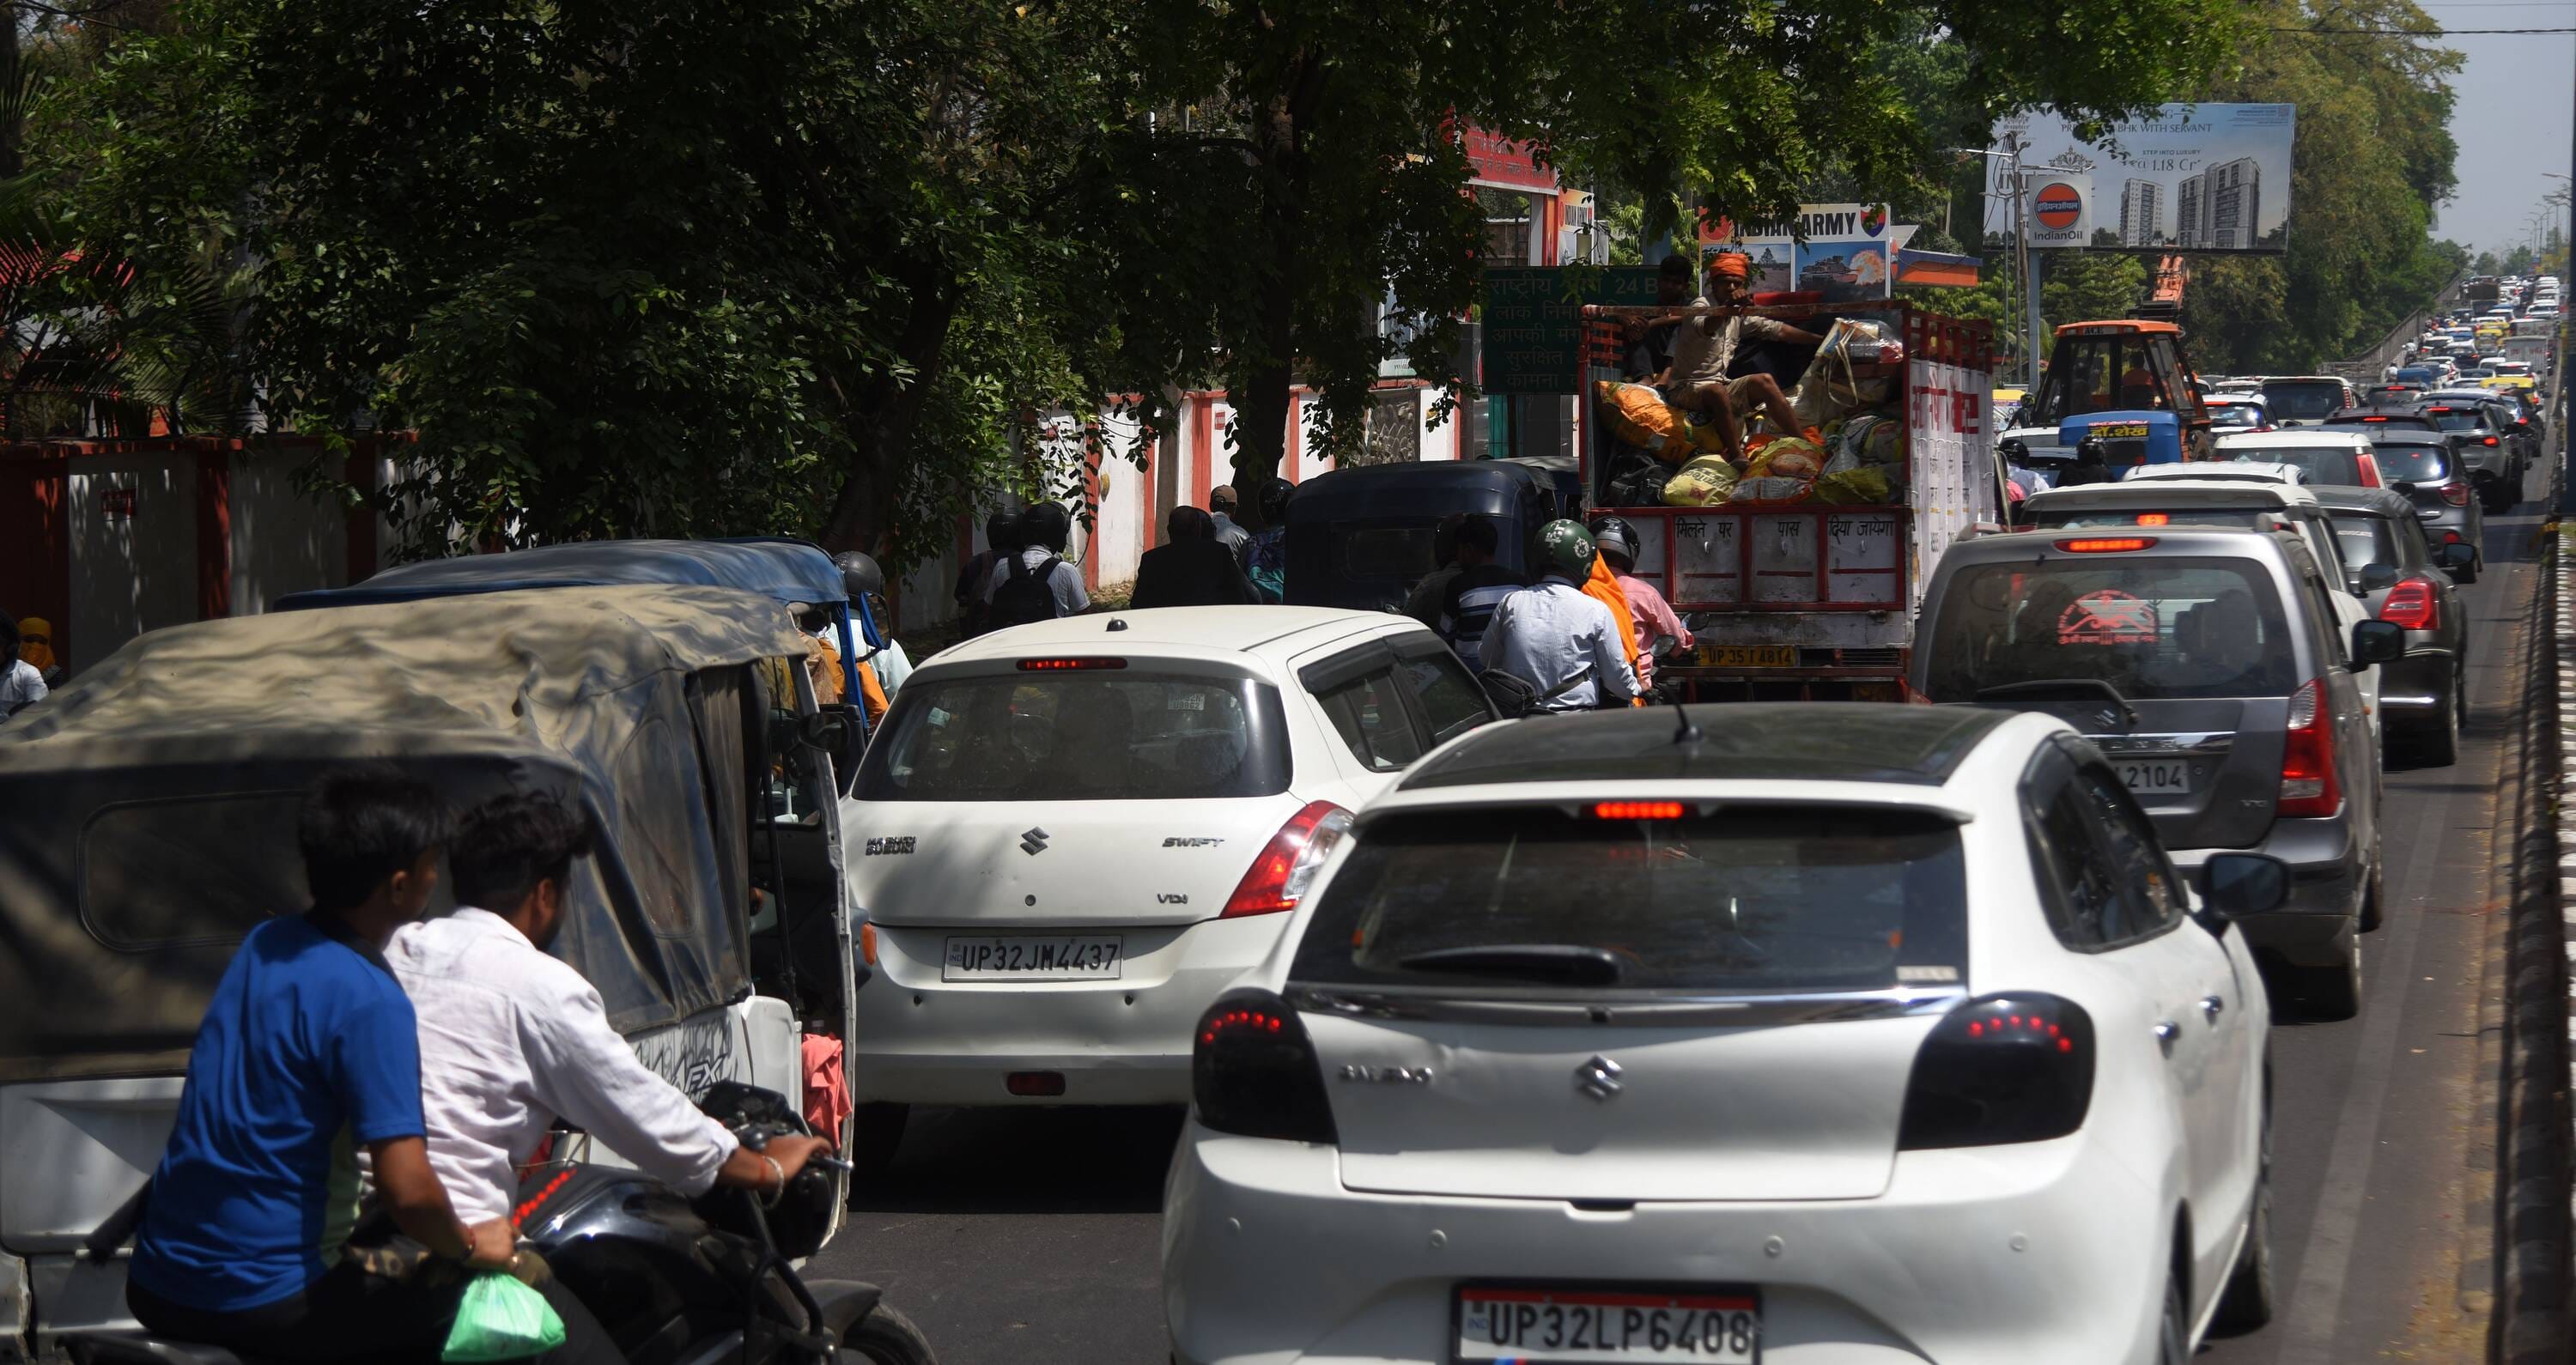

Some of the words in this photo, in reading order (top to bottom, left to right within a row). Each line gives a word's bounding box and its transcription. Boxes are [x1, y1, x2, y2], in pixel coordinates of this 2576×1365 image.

[2117, 124, 2137, 132] BHK
[2140, 124, 2167, 132] WITH
[2170, 123, 2213, 132] SERVANT
[2153, 159, 2174, 171] 1.18
[1801, 212, 1856, 235] ARMY
[2034, 230, 2083, 240] IndianOil
[1487, 271, 1552, 300] राष्ट्रीय
[1614, 277, 1638, 294] 24
[1645, 276, 1659, 294] B
[1495, 300, 1533, 320] लोक
[1491, 322, 1546, 343] आपकी
[1504, 345, 1564, 371] सुरक्षित
[1504, 373, 1560, 390] कामना
[1676, 517, 1706, 537] मिलने
[1717, 521, 1733, 537] पर
[1777, 521, 1801, 537] पास
[1827, 515, 1854, 544] दिया
[1857, 516, 1894, 537] जायेगा
[1708, 647, 1725, 663] UP
[1728, 648, 1745, 663] 35
[2113, 765, 2183, 788] 2104
[865, 845, 914, 856] SUZUKI
[1162, 837, 1225, 847] SWIFT
[962, 943, 1118, 972] UP32JM4437
[684, 1053, 727, 1093] FX
[1489, 1302, 1751, 1355] UP32LP6408
